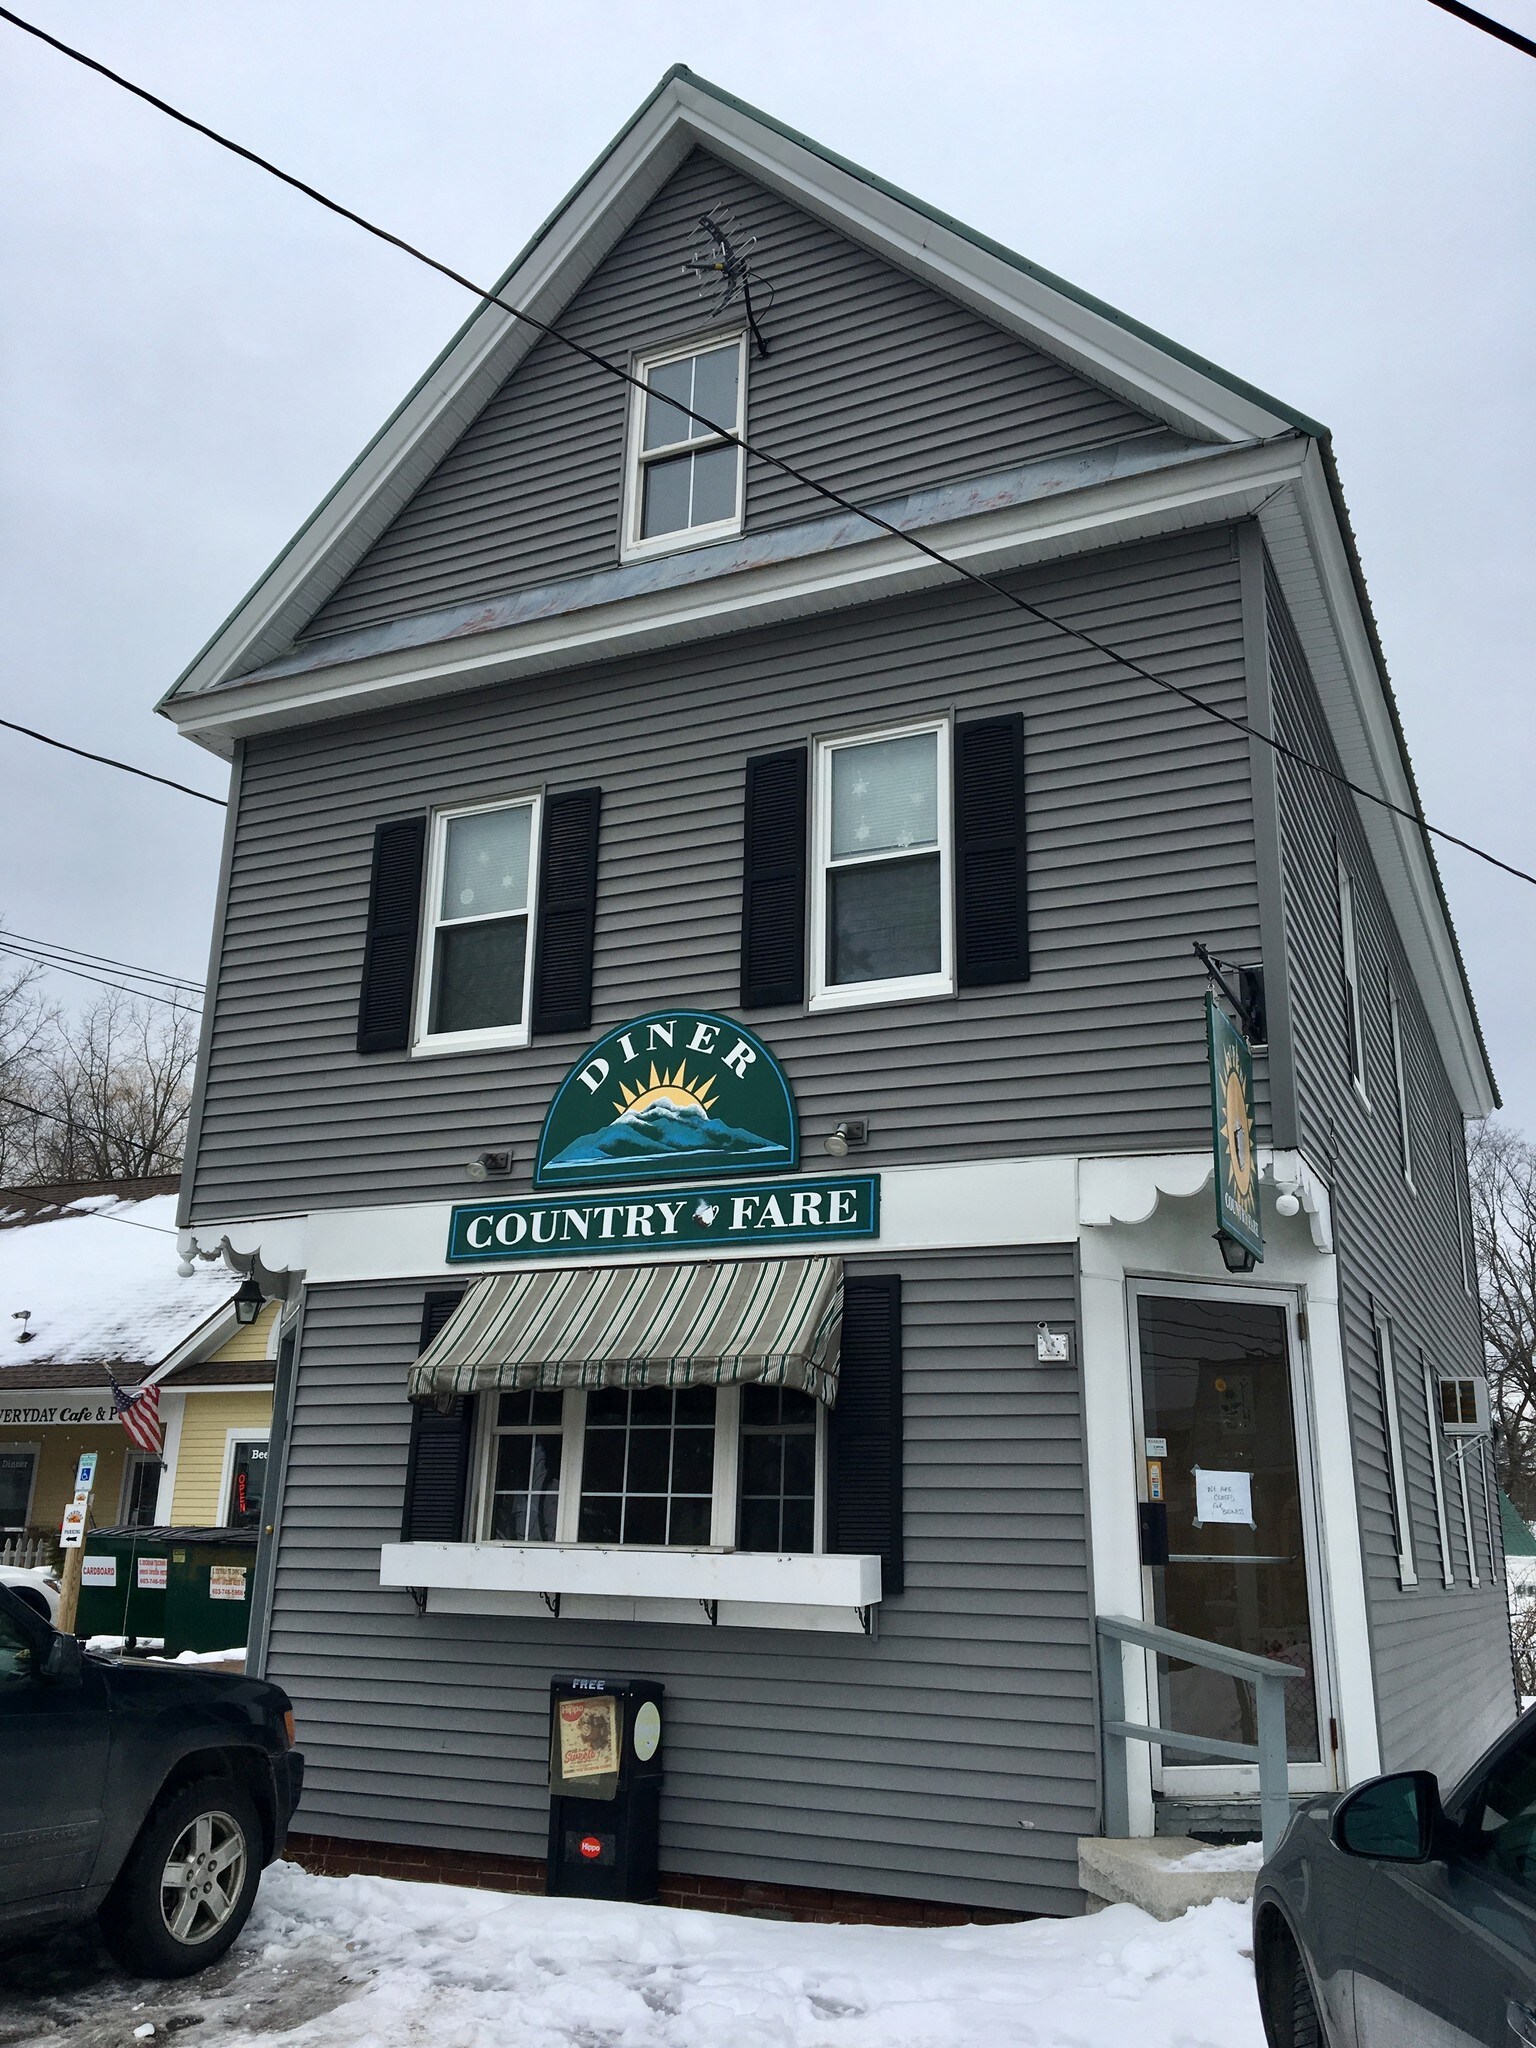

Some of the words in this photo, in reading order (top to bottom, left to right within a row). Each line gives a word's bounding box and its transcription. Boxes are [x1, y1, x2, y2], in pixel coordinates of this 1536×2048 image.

[577, 1020, 757, 1095] DINER
[466, 1201, 687, 1249] COUNTRY
[728, 1189, 858, 1231] FARE
[60, 1407, 92, 1423] Cafe
[96, 1406, 106, 1421] &
[2, 1459, 28, 1468] Dinner
[238, 1474, 246, 1513] OPEN
[83, 1566, 115, 1575] CARDBOARD
[572, 1678, 605, 1690] FREE
[562, 1705, 584, 1715] Hippo
[581, 1842, 600, 1852] Hippo
